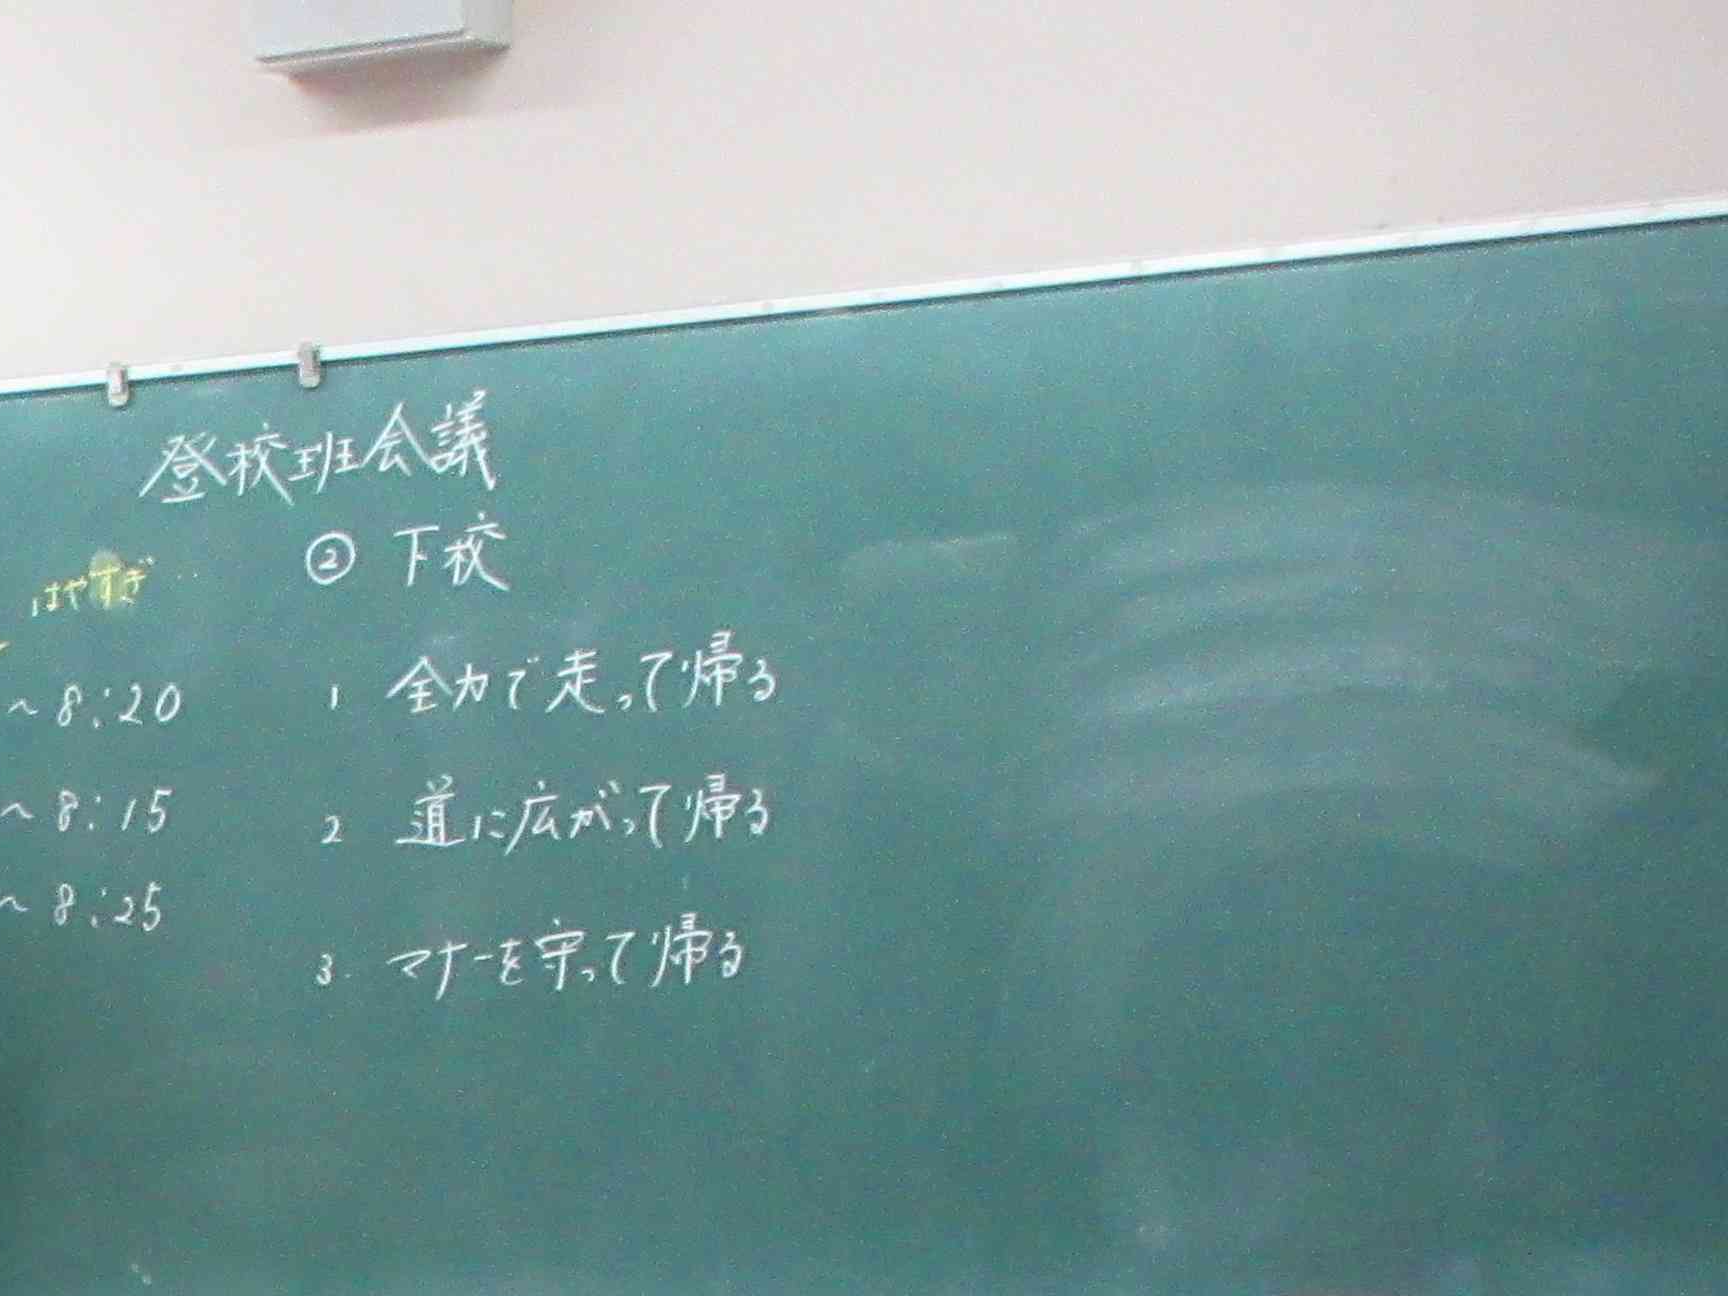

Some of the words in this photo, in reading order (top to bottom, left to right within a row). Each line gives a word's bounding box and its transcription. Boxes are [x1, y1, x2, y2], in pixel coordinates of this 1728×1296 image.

[140, 390, 497, 504] 登校班会議
[395, 511, 510, 591] 下校
[386, 629, 777, 714] 全力で走って帰る
[395, 773, 769, 856] 道に広がって帰る
[386, 912, 745, 1001] マナーを守って帰る
